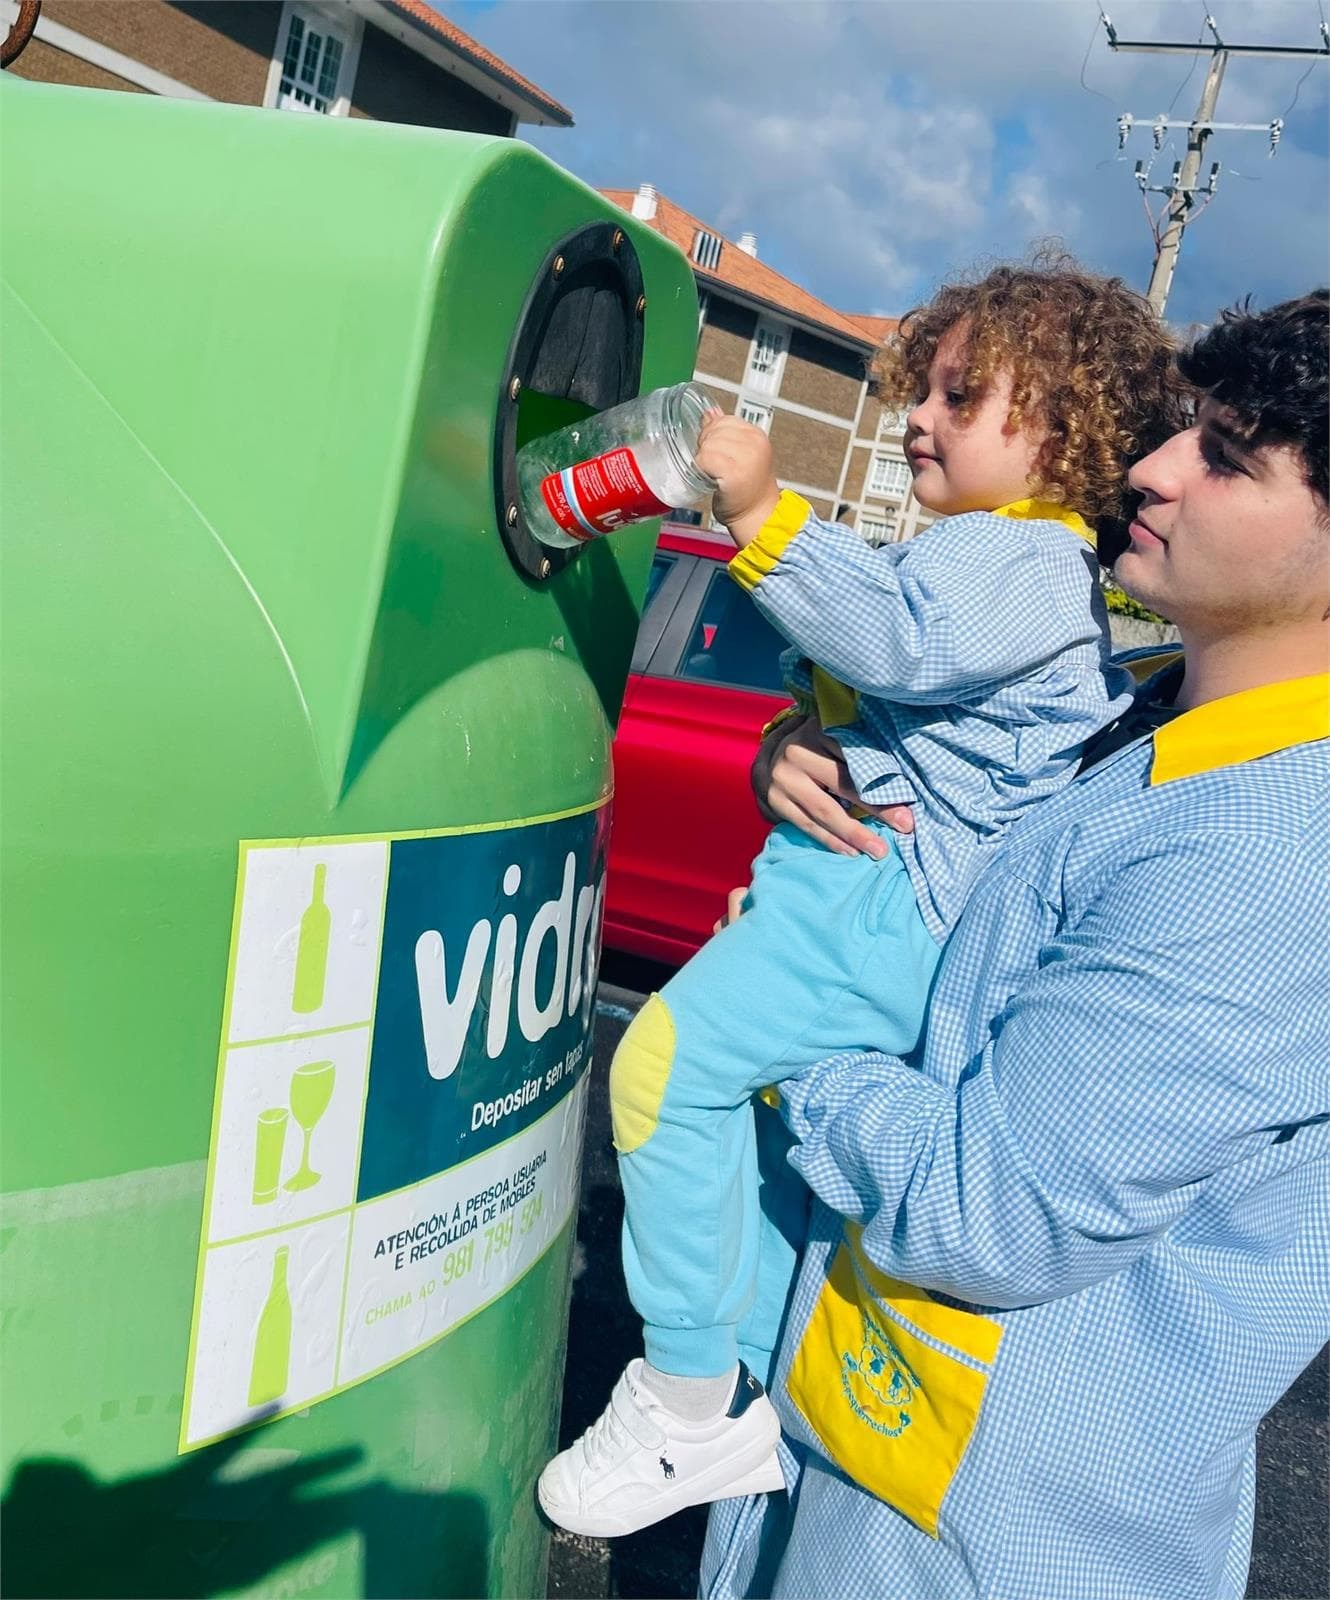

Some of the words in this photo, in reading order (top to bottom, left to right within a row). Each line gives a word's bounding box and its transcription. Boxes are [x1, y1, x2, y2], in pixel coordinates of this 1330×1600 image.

[471, 1076, 543, 1131] Depositar
[545, 1061, 563, 1092] sen
[374, 1212, 448, 1259] ATENCIÓN
[465, 1178, 510, 1216] PERSOA
[513, 1150, 547, 1188] USUARIA
[394, 1252, 404, 1271] E
[409, 1214, 478, 1264] RECOLLIDA
[482, 1203, 497, 1225] DE
[500, 1175, 536, 1214] MOBLES
[365, 1292, 412, 1326] CHAMA
[418, 1279, 436, 1301] AO
[442, 1237, 475, 1287] 981
